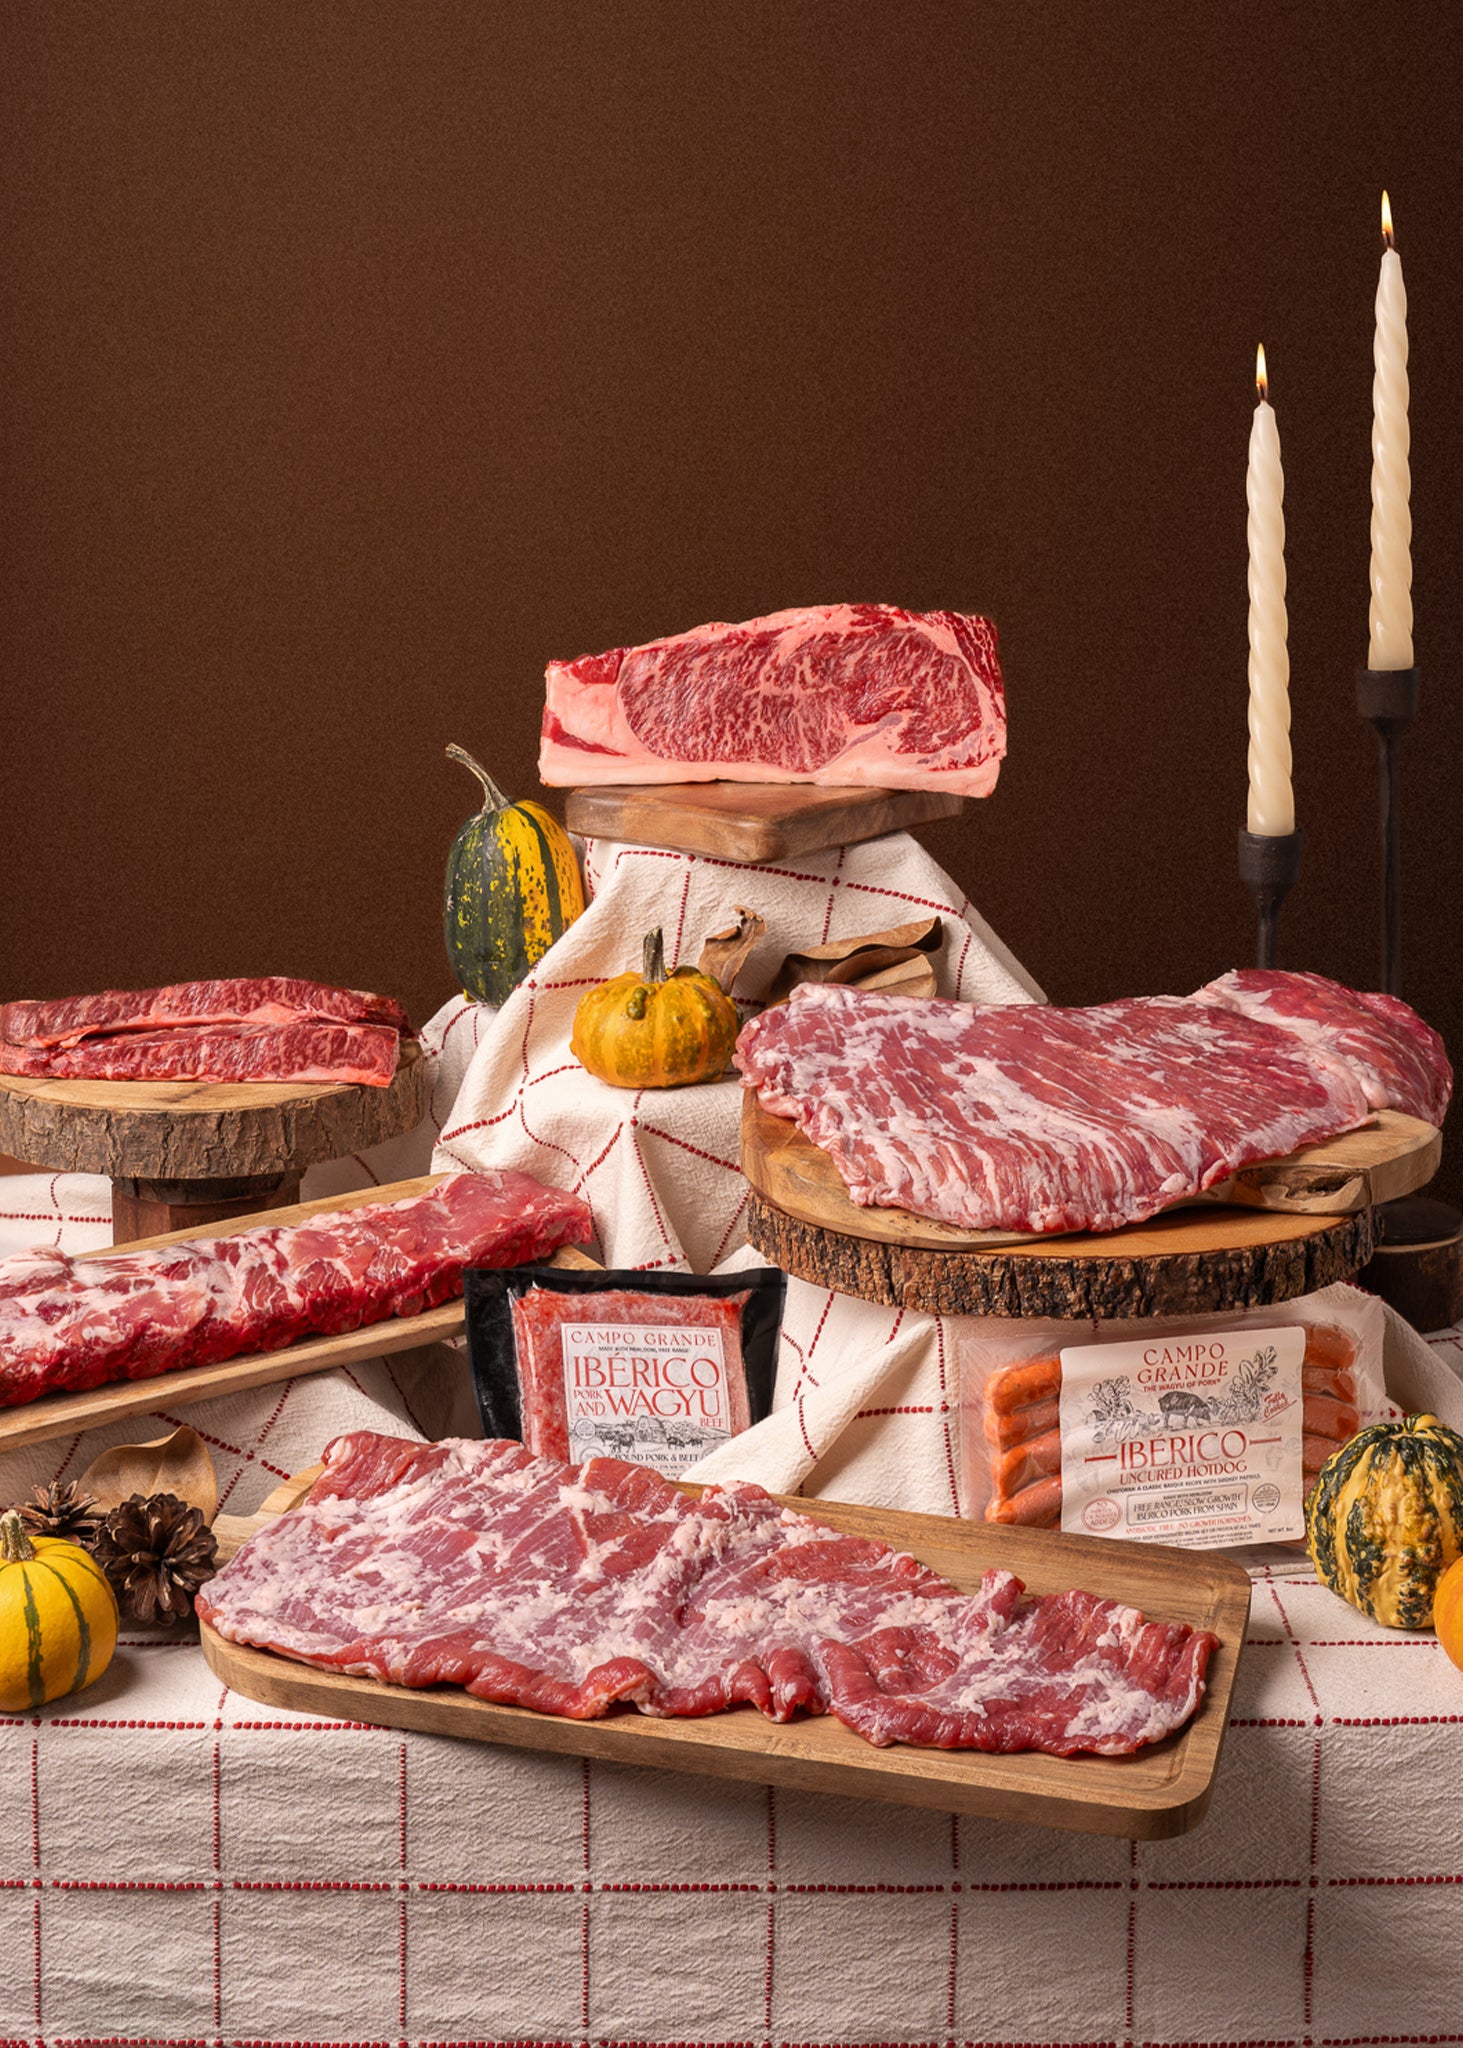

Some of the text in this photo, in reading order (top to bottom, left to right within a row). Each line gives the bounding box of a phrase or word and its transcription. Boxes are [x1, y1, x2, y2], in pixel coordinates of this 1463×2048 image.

[570, 1331, 716, 1347] CAMPO GRANDE
[1143, 1342, 1225, 1366] CAMPO
[573, 1352, 720, 1389] IBÉRICO
[1137, 1360, 1229, 1384] GRANDE
[1158, 1382, 1185, 1391] WAGYU
[573, 1388, 720, 1417] PORK WAGYU
[1264, 1391, 1289, 1405] Fully
[575, 1401, 606, 1416] AND
[700, 1417, 724, 1427] BEEF
[645, 1453, 669, 1462] PORK
[670, 1454, 677, 1462] &
[678, 1453, 698, 1462] BEEF
[1119, 1430, 1247, 1470] IBÉRICO
[1119, 1460, 1248, 1485] UNCURED HOTDOG
[1133, 1503, 1154, 1513] FREE
[1169, 1507, 1192, 1517] PORK
[1193, 1504, 1215, 1514] FROM
[1216, 1502, 1238, 1511] SPAIN
